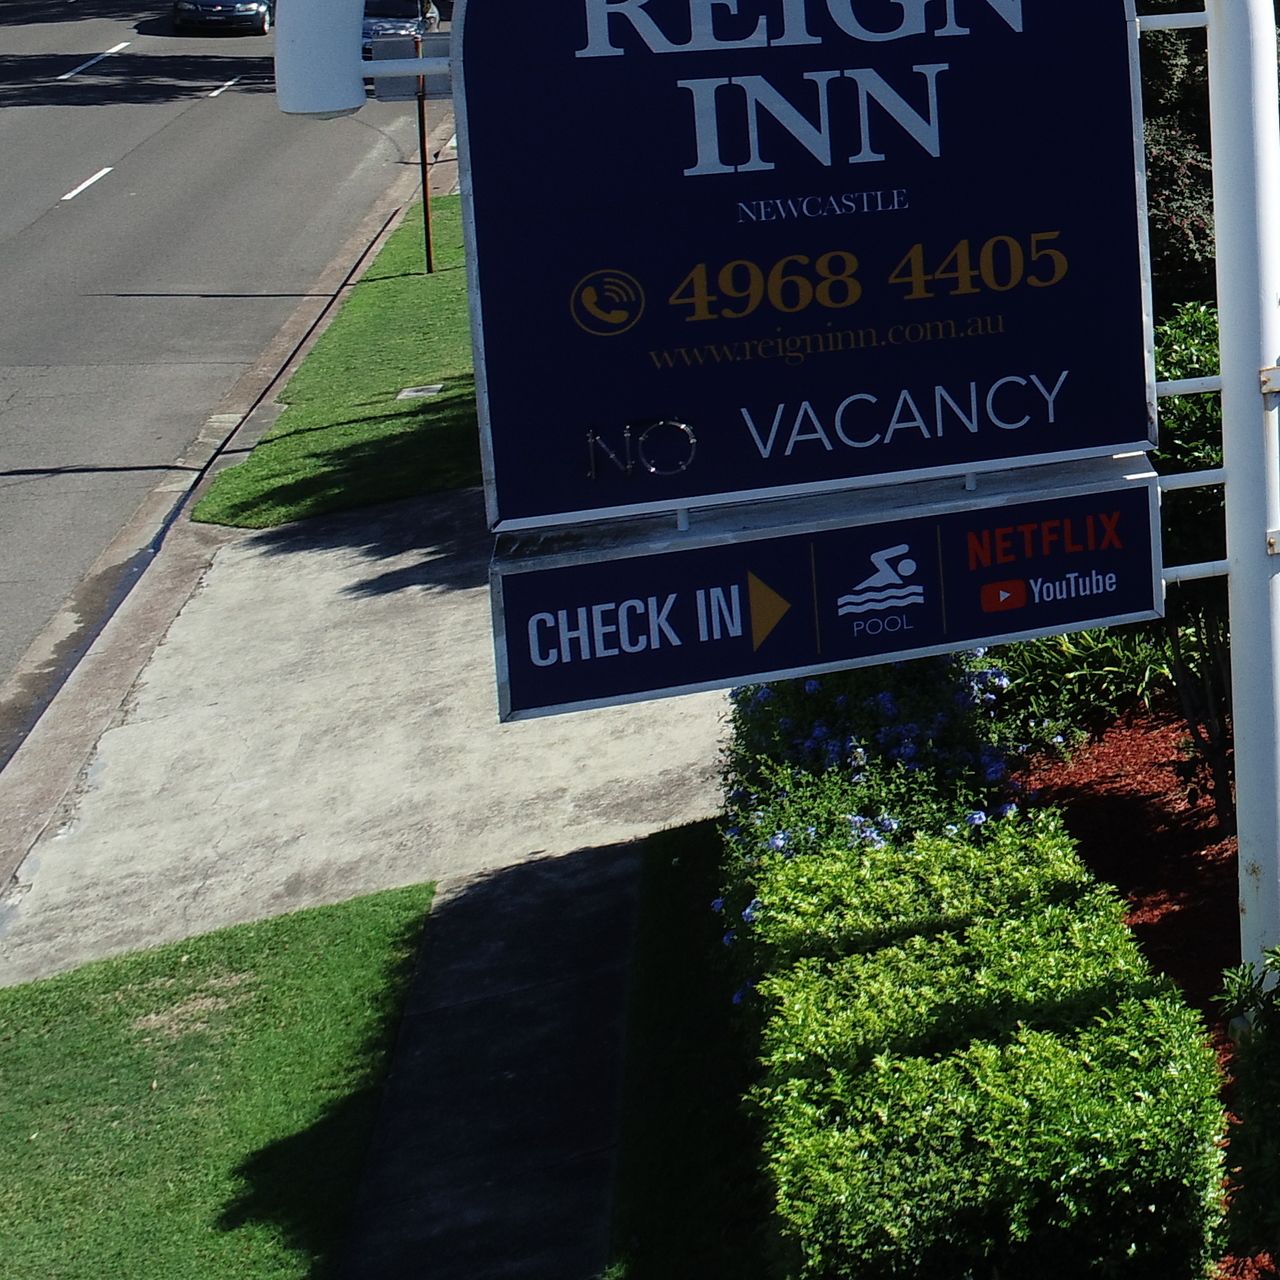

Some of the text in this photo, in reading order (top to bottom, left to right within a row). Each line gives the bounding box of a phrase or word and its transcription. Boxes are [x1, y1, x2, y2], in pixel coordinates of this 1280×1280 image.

[677, 63, 949, 176] INN
[737, 189, 909, 223] NEWCASTLE
[668, 231, 1068, 321] 4968 4405
[649, 314, 1006, 370] www.reigninn.com.au
[586, 370, 1069, 479] NO VACANCY
[967, 511, 1122, 571] NETFLIX
[1029, 569, 1117, 605] YouTube
[528, 585, 743, 667] CHECK IN
[854, 614, 914, 637] POOL
